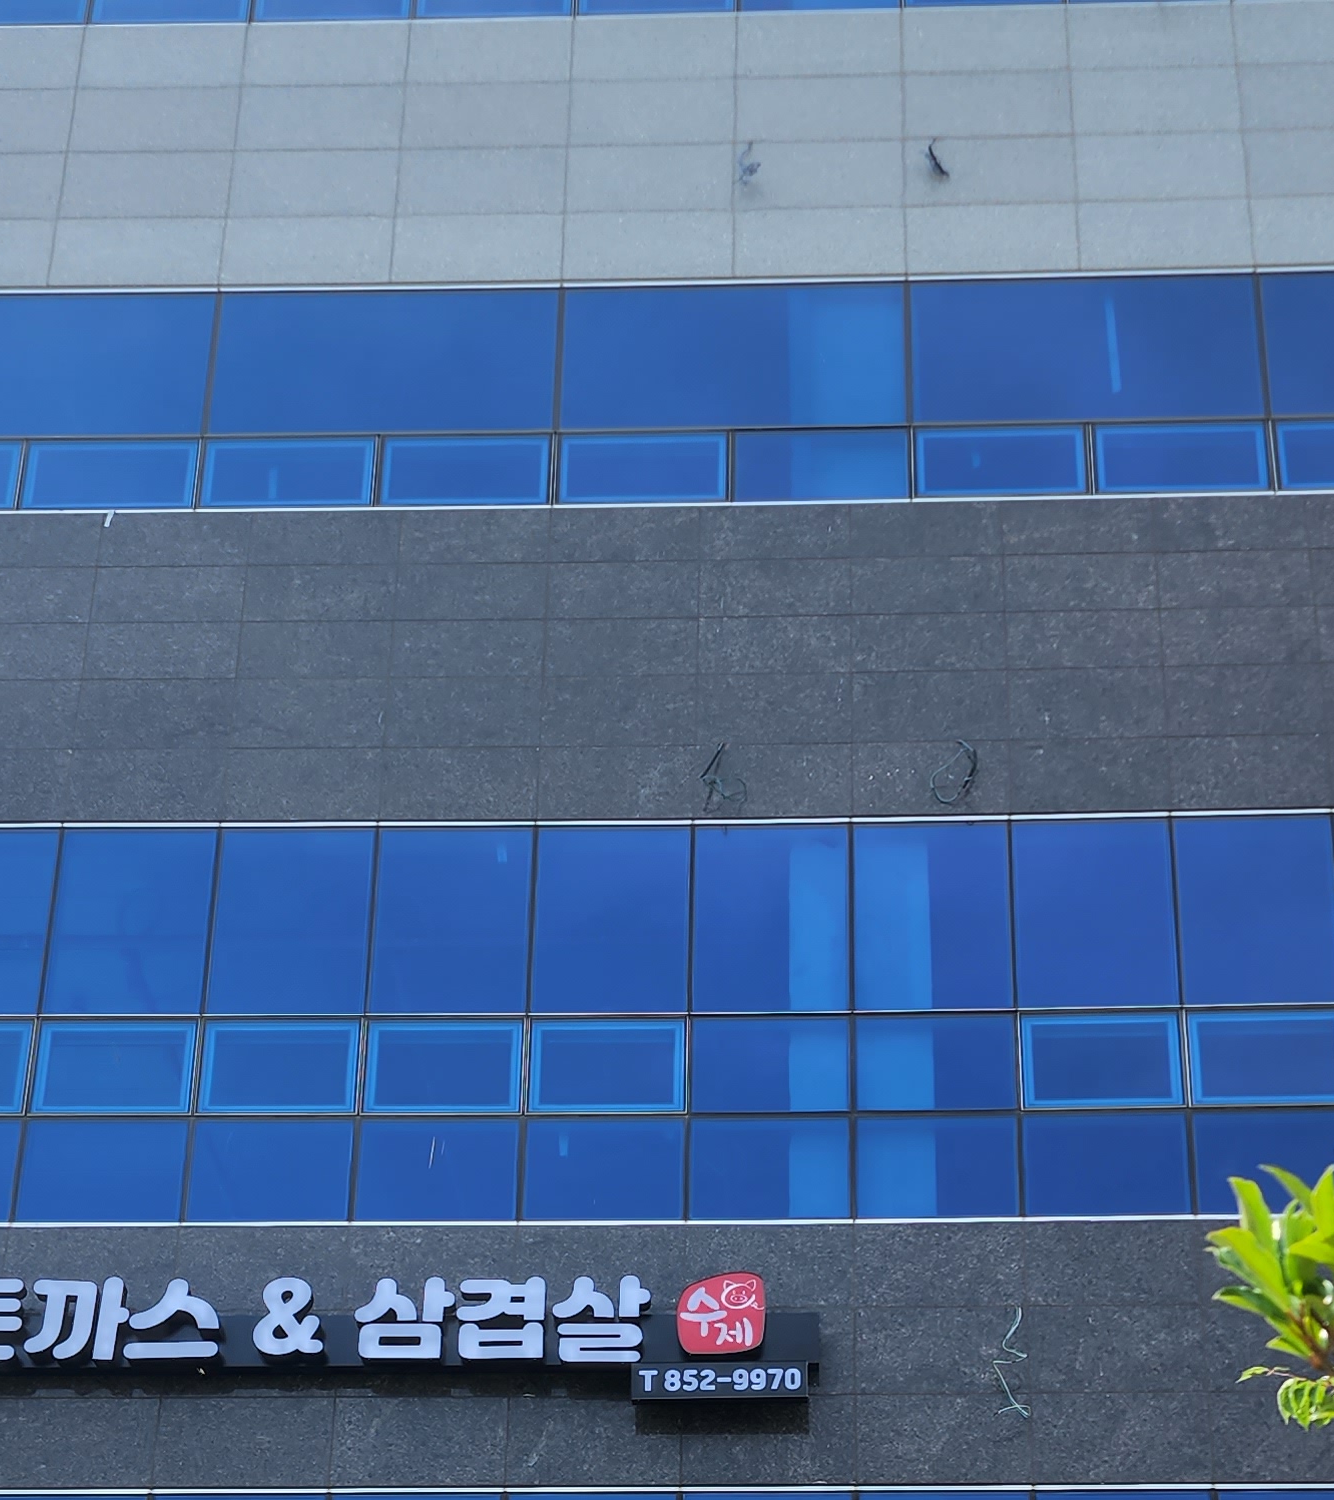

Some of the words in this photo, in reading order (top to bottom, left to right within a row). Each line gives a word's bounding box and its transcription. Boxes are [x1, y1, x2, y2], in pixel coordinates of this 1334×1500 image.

[253, 1276, 323, 1354] &
[354, 1275, 652, 1362] 삼겹살
[680, 1287, 753, 1346] 수제
[638, 1369, 658, 1391] T
[664, 1368, 801, 1391] 852-9970
